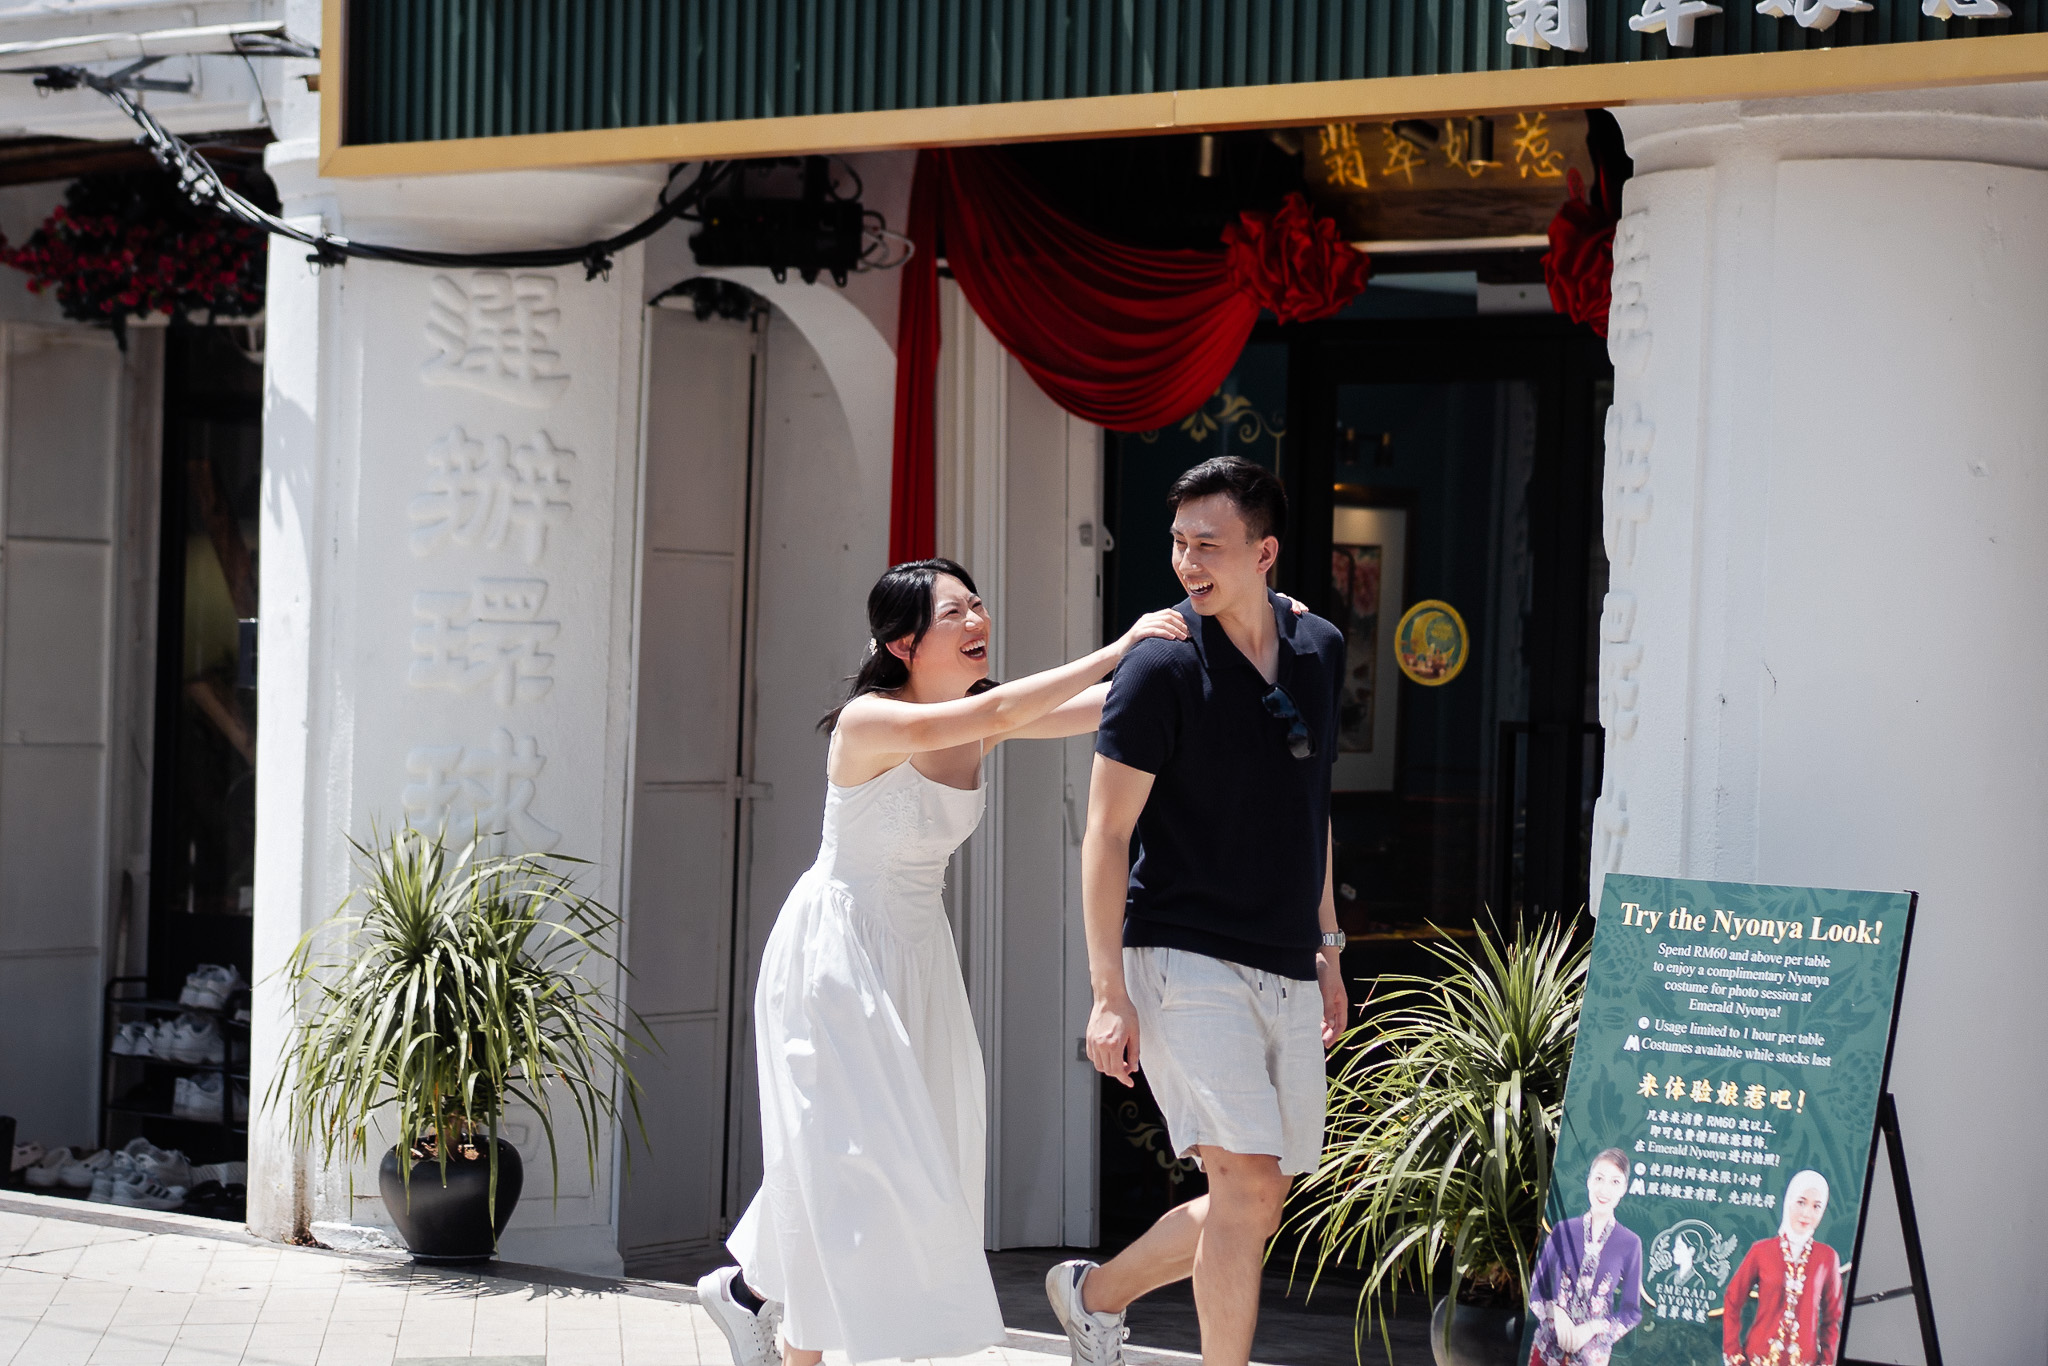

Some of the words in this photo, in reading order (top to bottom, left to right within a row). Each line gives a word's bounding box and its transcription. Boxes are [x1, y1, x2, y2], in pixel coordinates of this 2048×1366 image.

[1621, 902, 1663, 934] Try
[1669, 907, 1706, 931] the
[1711, 910, 1803, 944] Nyonya
[1808, 916, 1883, 944] Look!
[1658, 943, 1691, 958] Spend
[1693, 945, 1728, 960] RM60
[1729, 949, 1749, 962] and
[1750, 950, 1783, 964] above
[1784, 955, 1803, 968] per
[1804, 955, 1831, 968] table
[1653, 961, 1664, 972] to
[1666, 962, 1696, 977] enjoy
[1697, 967, 1705, 975] a
[1706, 966, 1786, 985] complimentary
[1787, 971, 1829, 988] Nyonya
[1664, 981, 1709, 993] costume
[1710, 982, 1728, 995] for
[1728, 984, 1759, 999] photo
[1760, 988, 1799, 1001] session
[1800, 992, 1812, 1002] at
[1688, 998, 1734, 1013] Emerald
[1735, 1002, 1781, 1019] Nyonya!
[1655, 1019, 1688, 1036] Usage
[1689, 1022, 1727, 1037] limited
[1729, 1028, 1740, 1038] to
[1743, 1027, 1748, 1039] 1
[1751, 1028, 1777, 1041] hour
[1778, 1034, 1797, 1045] per
[1798, 1033, 1825, 1046] table
[1641, 1037, 1693, 1053] Costumes
[1694, 1044, 1743, 1058] available
[1745, 1048, 1775, 1062] while
[1776, 1052, 1810, 1065] stocks
[1811, 1053, 1832, 1067] last
[1706, 1115, 1737, 1130] RM60
[1648, 1141, 1688, 1156] Emerald
[1689, 1145, 1727, 1162] Nyonya
[1656, 1283, 1717, 1300] EMERALD
[1658, 1293, 1710, 1310] NYONYA
